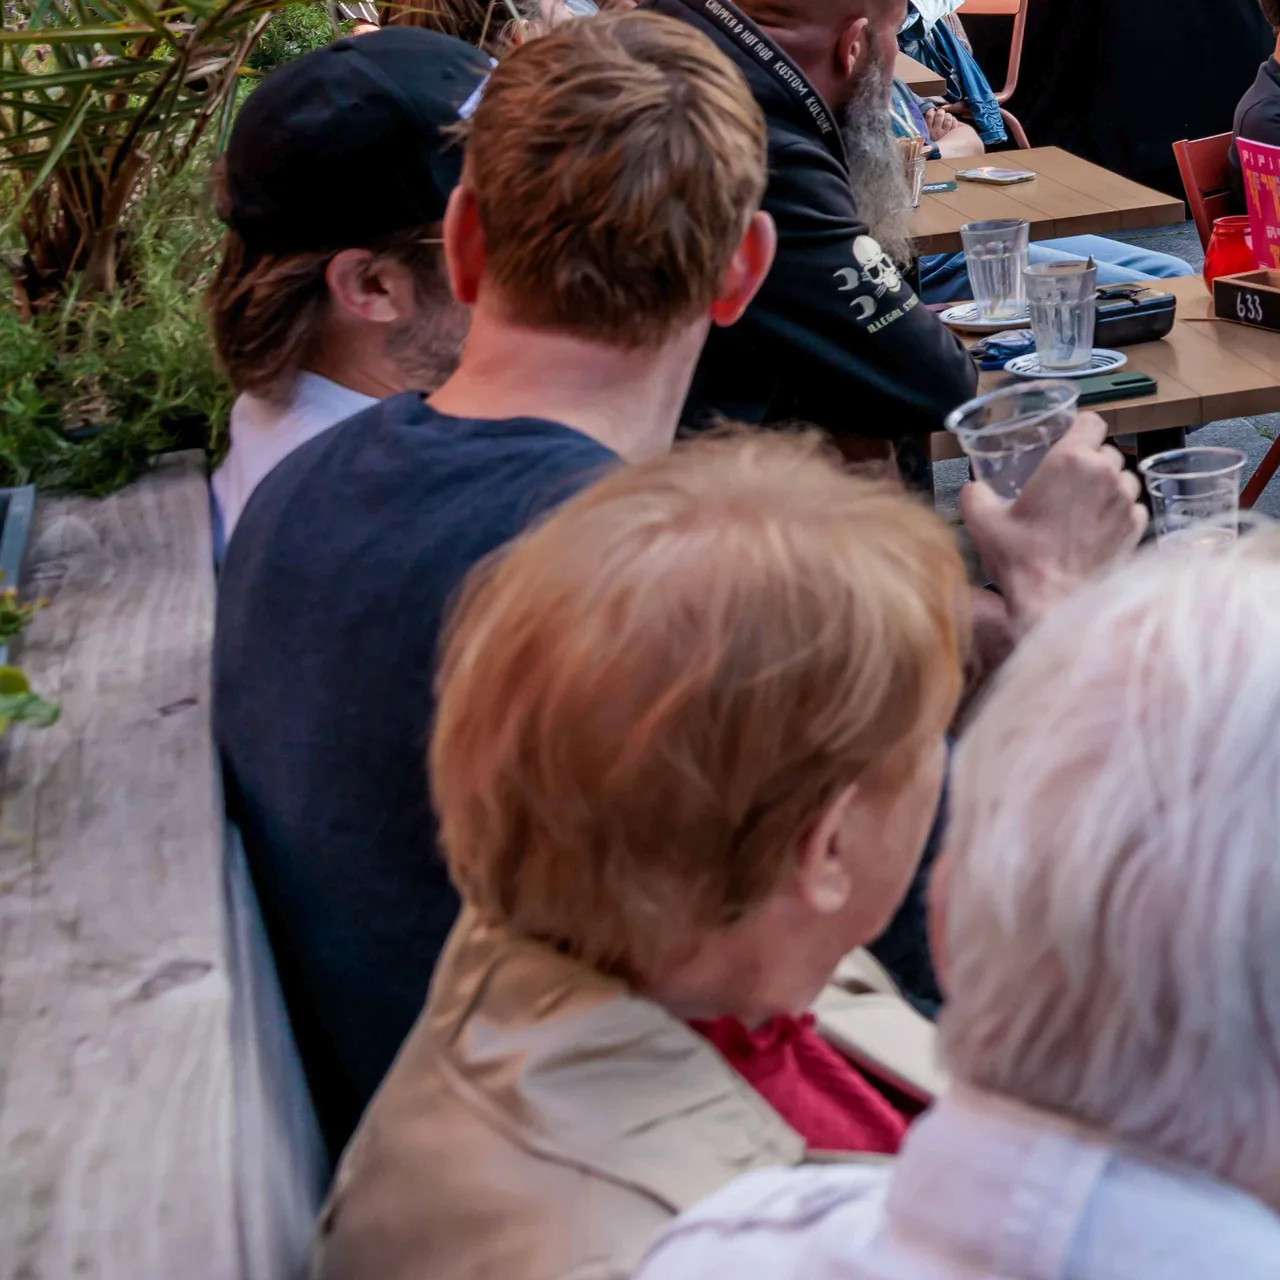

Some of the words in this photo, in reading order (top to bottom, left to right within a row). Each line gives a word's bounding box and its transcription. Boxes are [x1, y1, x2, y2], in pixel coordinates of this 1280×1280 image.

[741, 29, 759, 47] HOT
[773, 60, 809, 96] KUSTOM
[805, 95, 832, 135] KULTURE
[1236, 291, 1263, 321] 633
